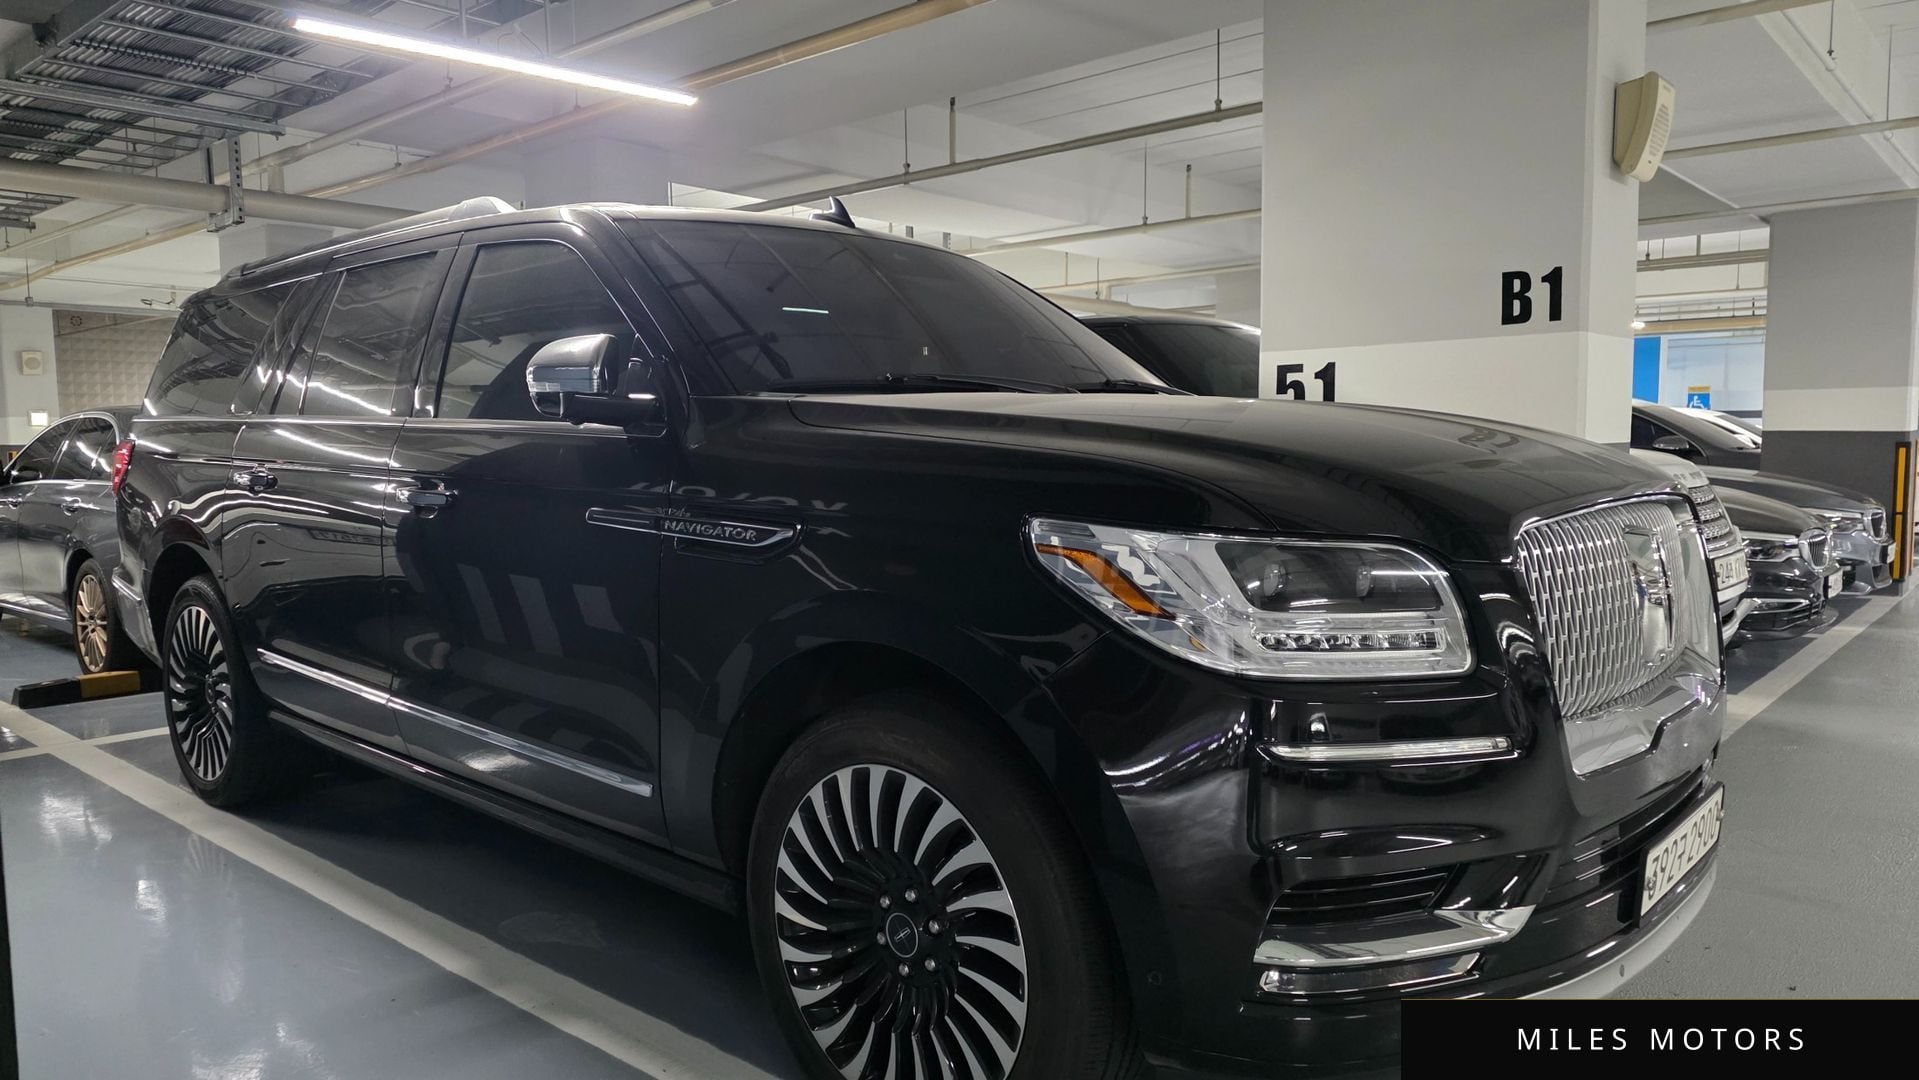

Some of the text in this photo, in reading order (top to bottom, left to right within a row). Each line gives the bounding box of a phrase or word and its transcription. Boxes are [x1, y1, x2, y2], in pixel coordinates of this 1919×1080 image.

[1501, 266, 1562, 325] B1
[1276, 362, 1336, 402] 51
[663, 518, 757, 542] NAVIGATOR
